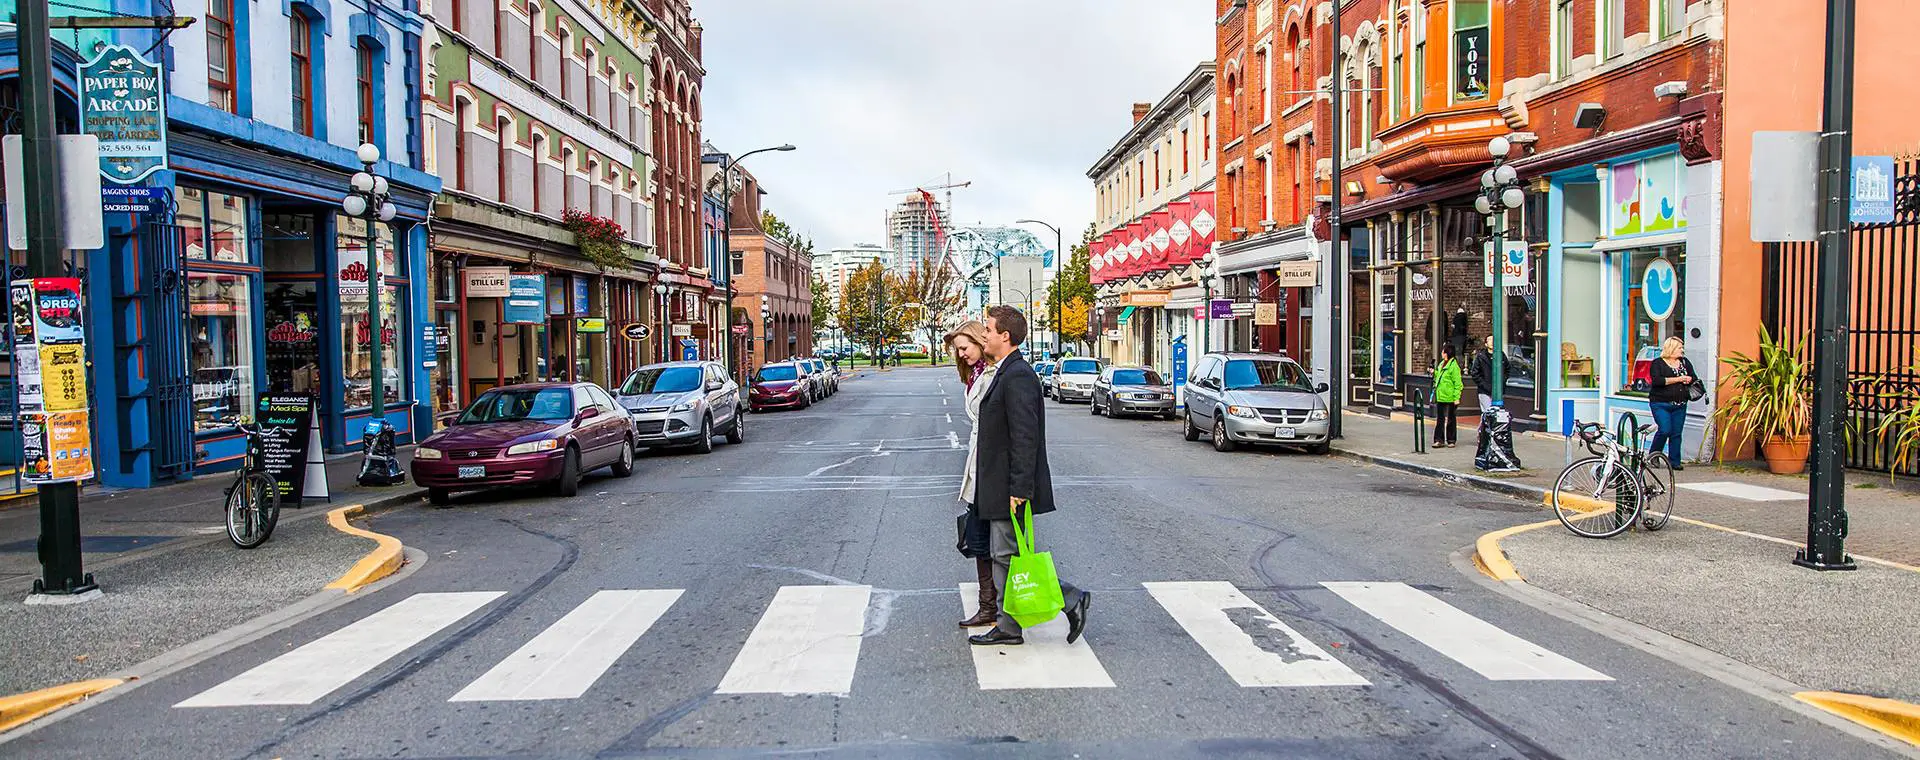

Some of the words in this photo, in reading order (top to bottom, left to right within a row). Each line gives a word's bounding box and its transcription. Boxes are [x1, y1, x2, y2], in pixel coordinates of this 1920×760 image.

[1467, 36, 1478, 89] YOGA
[84, 77, 128, 92] PAPER
[132, 77, 157, 92] BOX
[87, 97, 158, 112] ARCADE
[87, 117, 130, 125] SHOPPING
[118, 131, 159, 139] GARDENS
[1853, 208, 1892, 216] JOHNSON
[1489, 251, 1508, 262] hp
[347, 261, 365, 272] oh
[1408, 288, 1434, 300] SUASION
